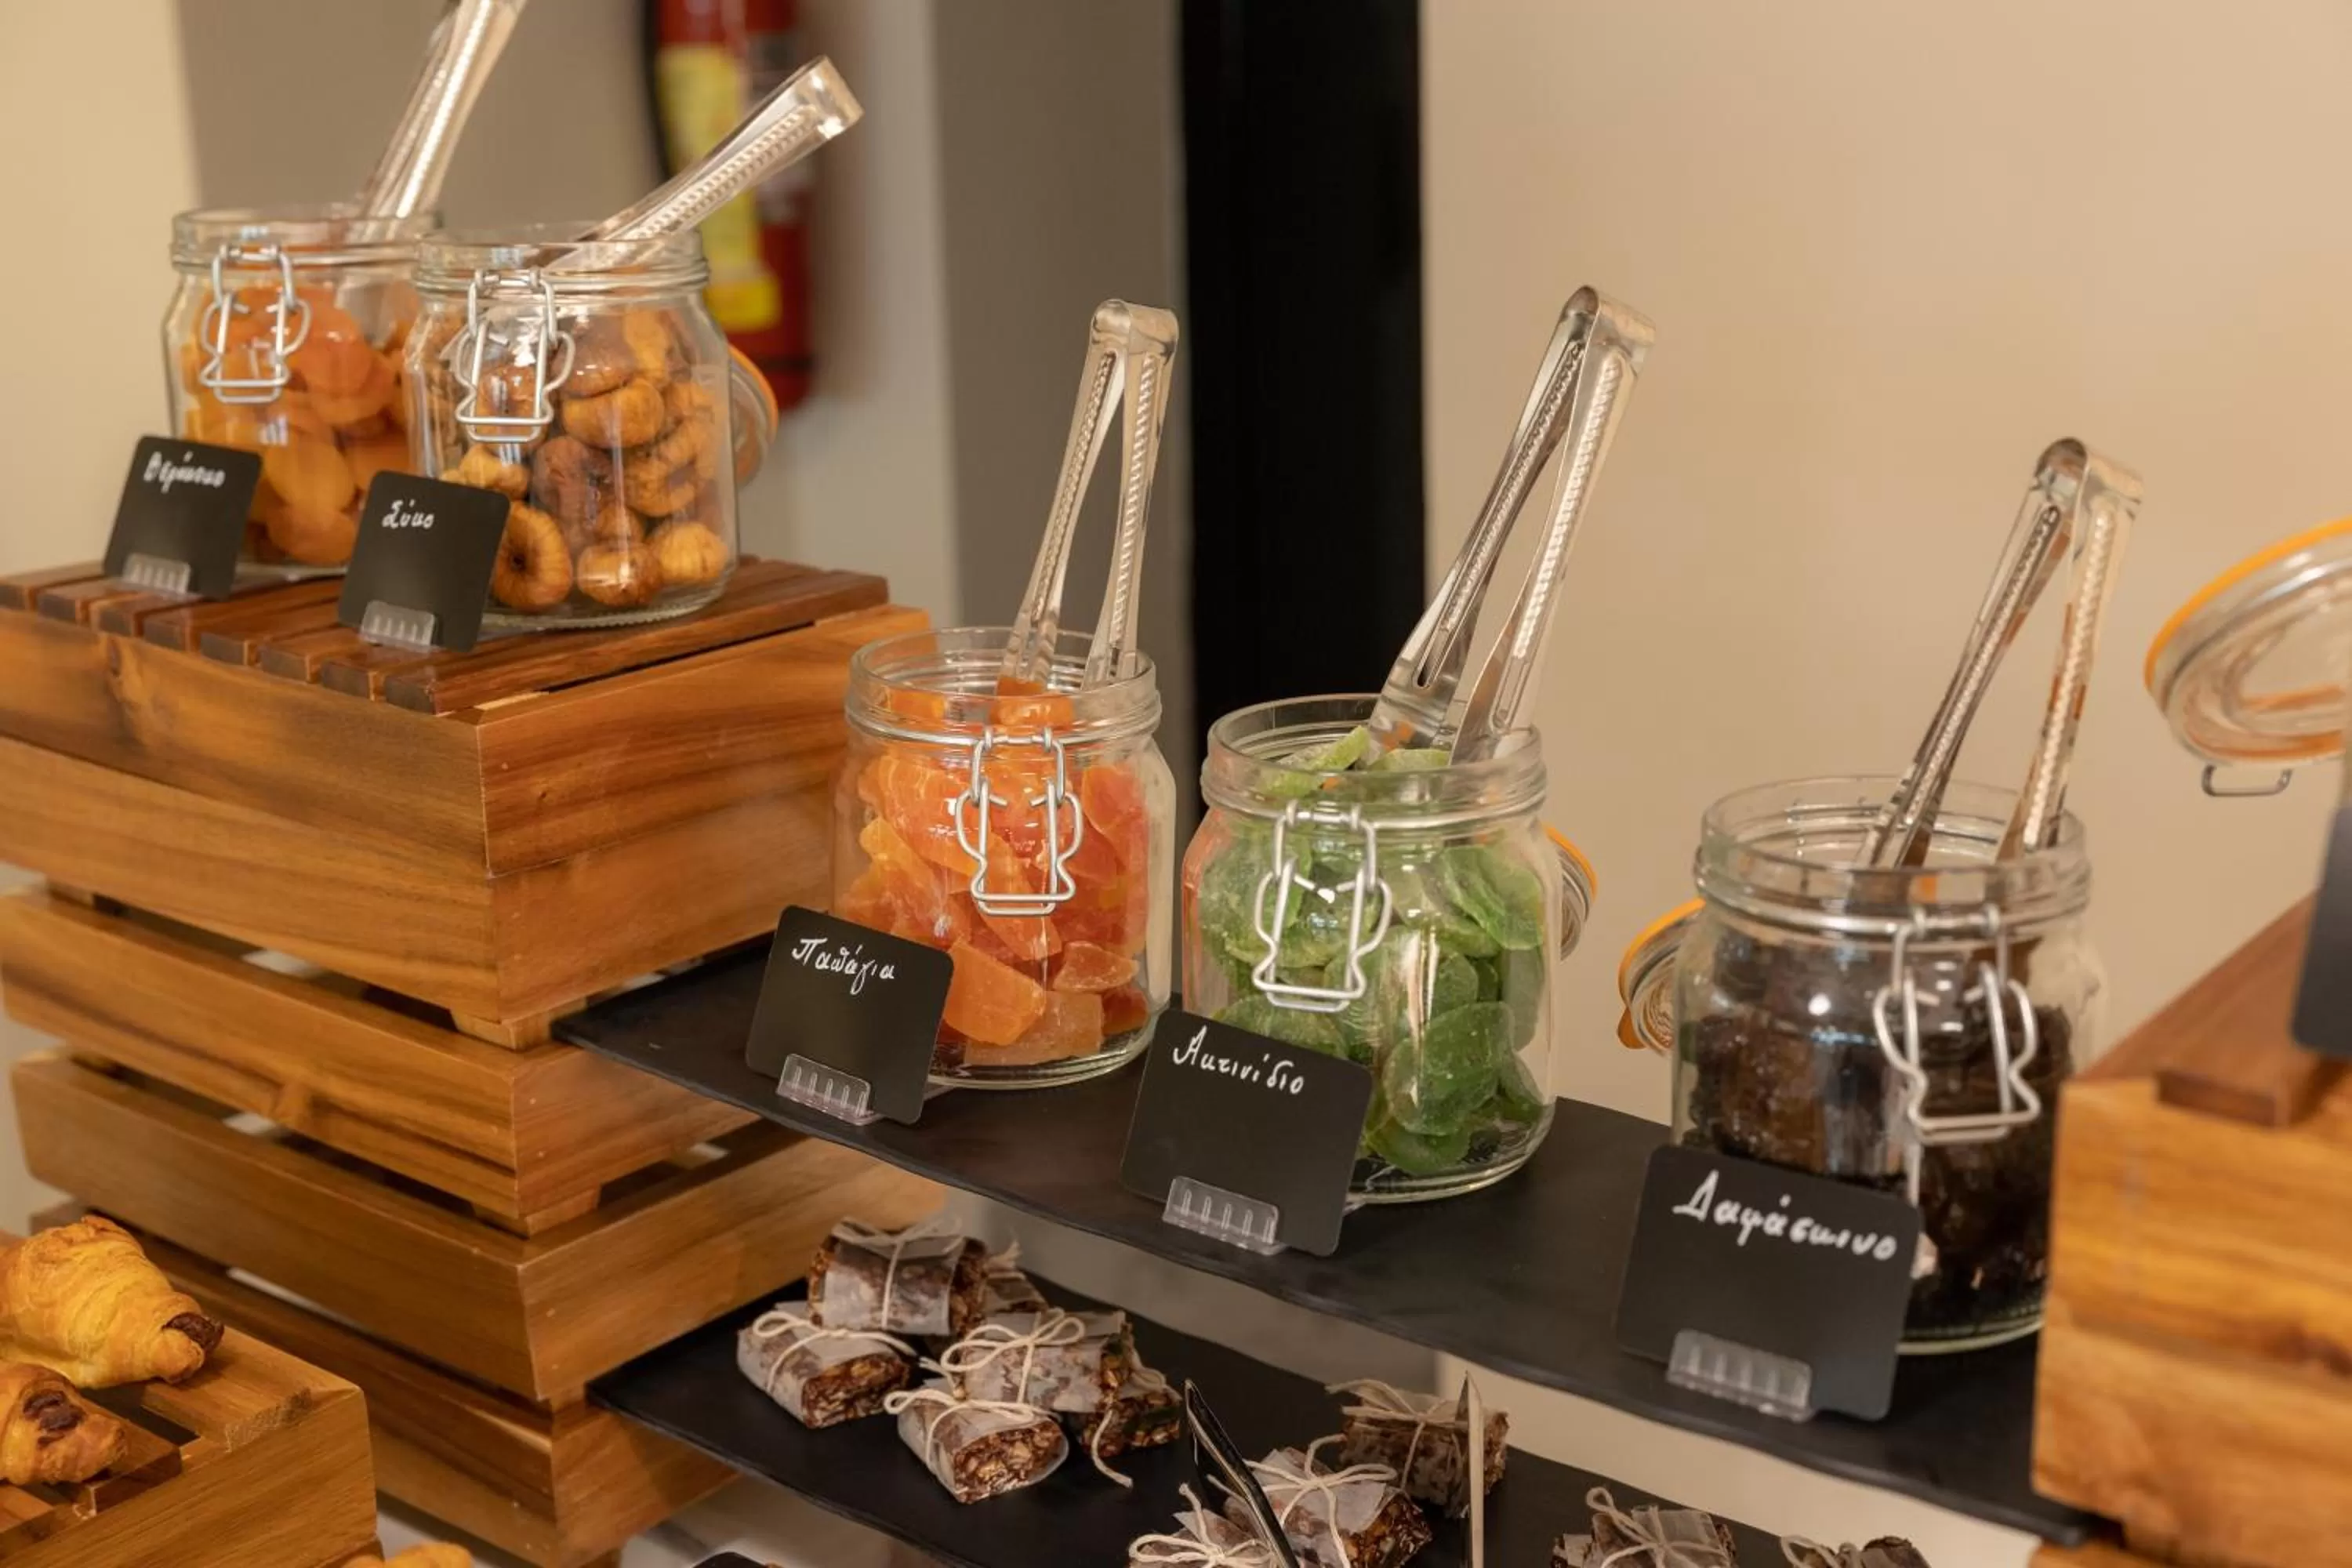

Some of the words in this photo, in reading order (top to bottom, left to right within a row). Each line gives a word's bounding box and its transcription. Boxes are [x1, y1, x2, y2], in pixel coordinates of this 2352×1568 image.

[382, 499, 435, 529] Σύκο
[791, 937, 895, 996] Παπάγια
[1173, 1025, 1305, 1094] Ακτινίδιο
[1671, 1170, 1897, 1261] Δαμάσκινο
